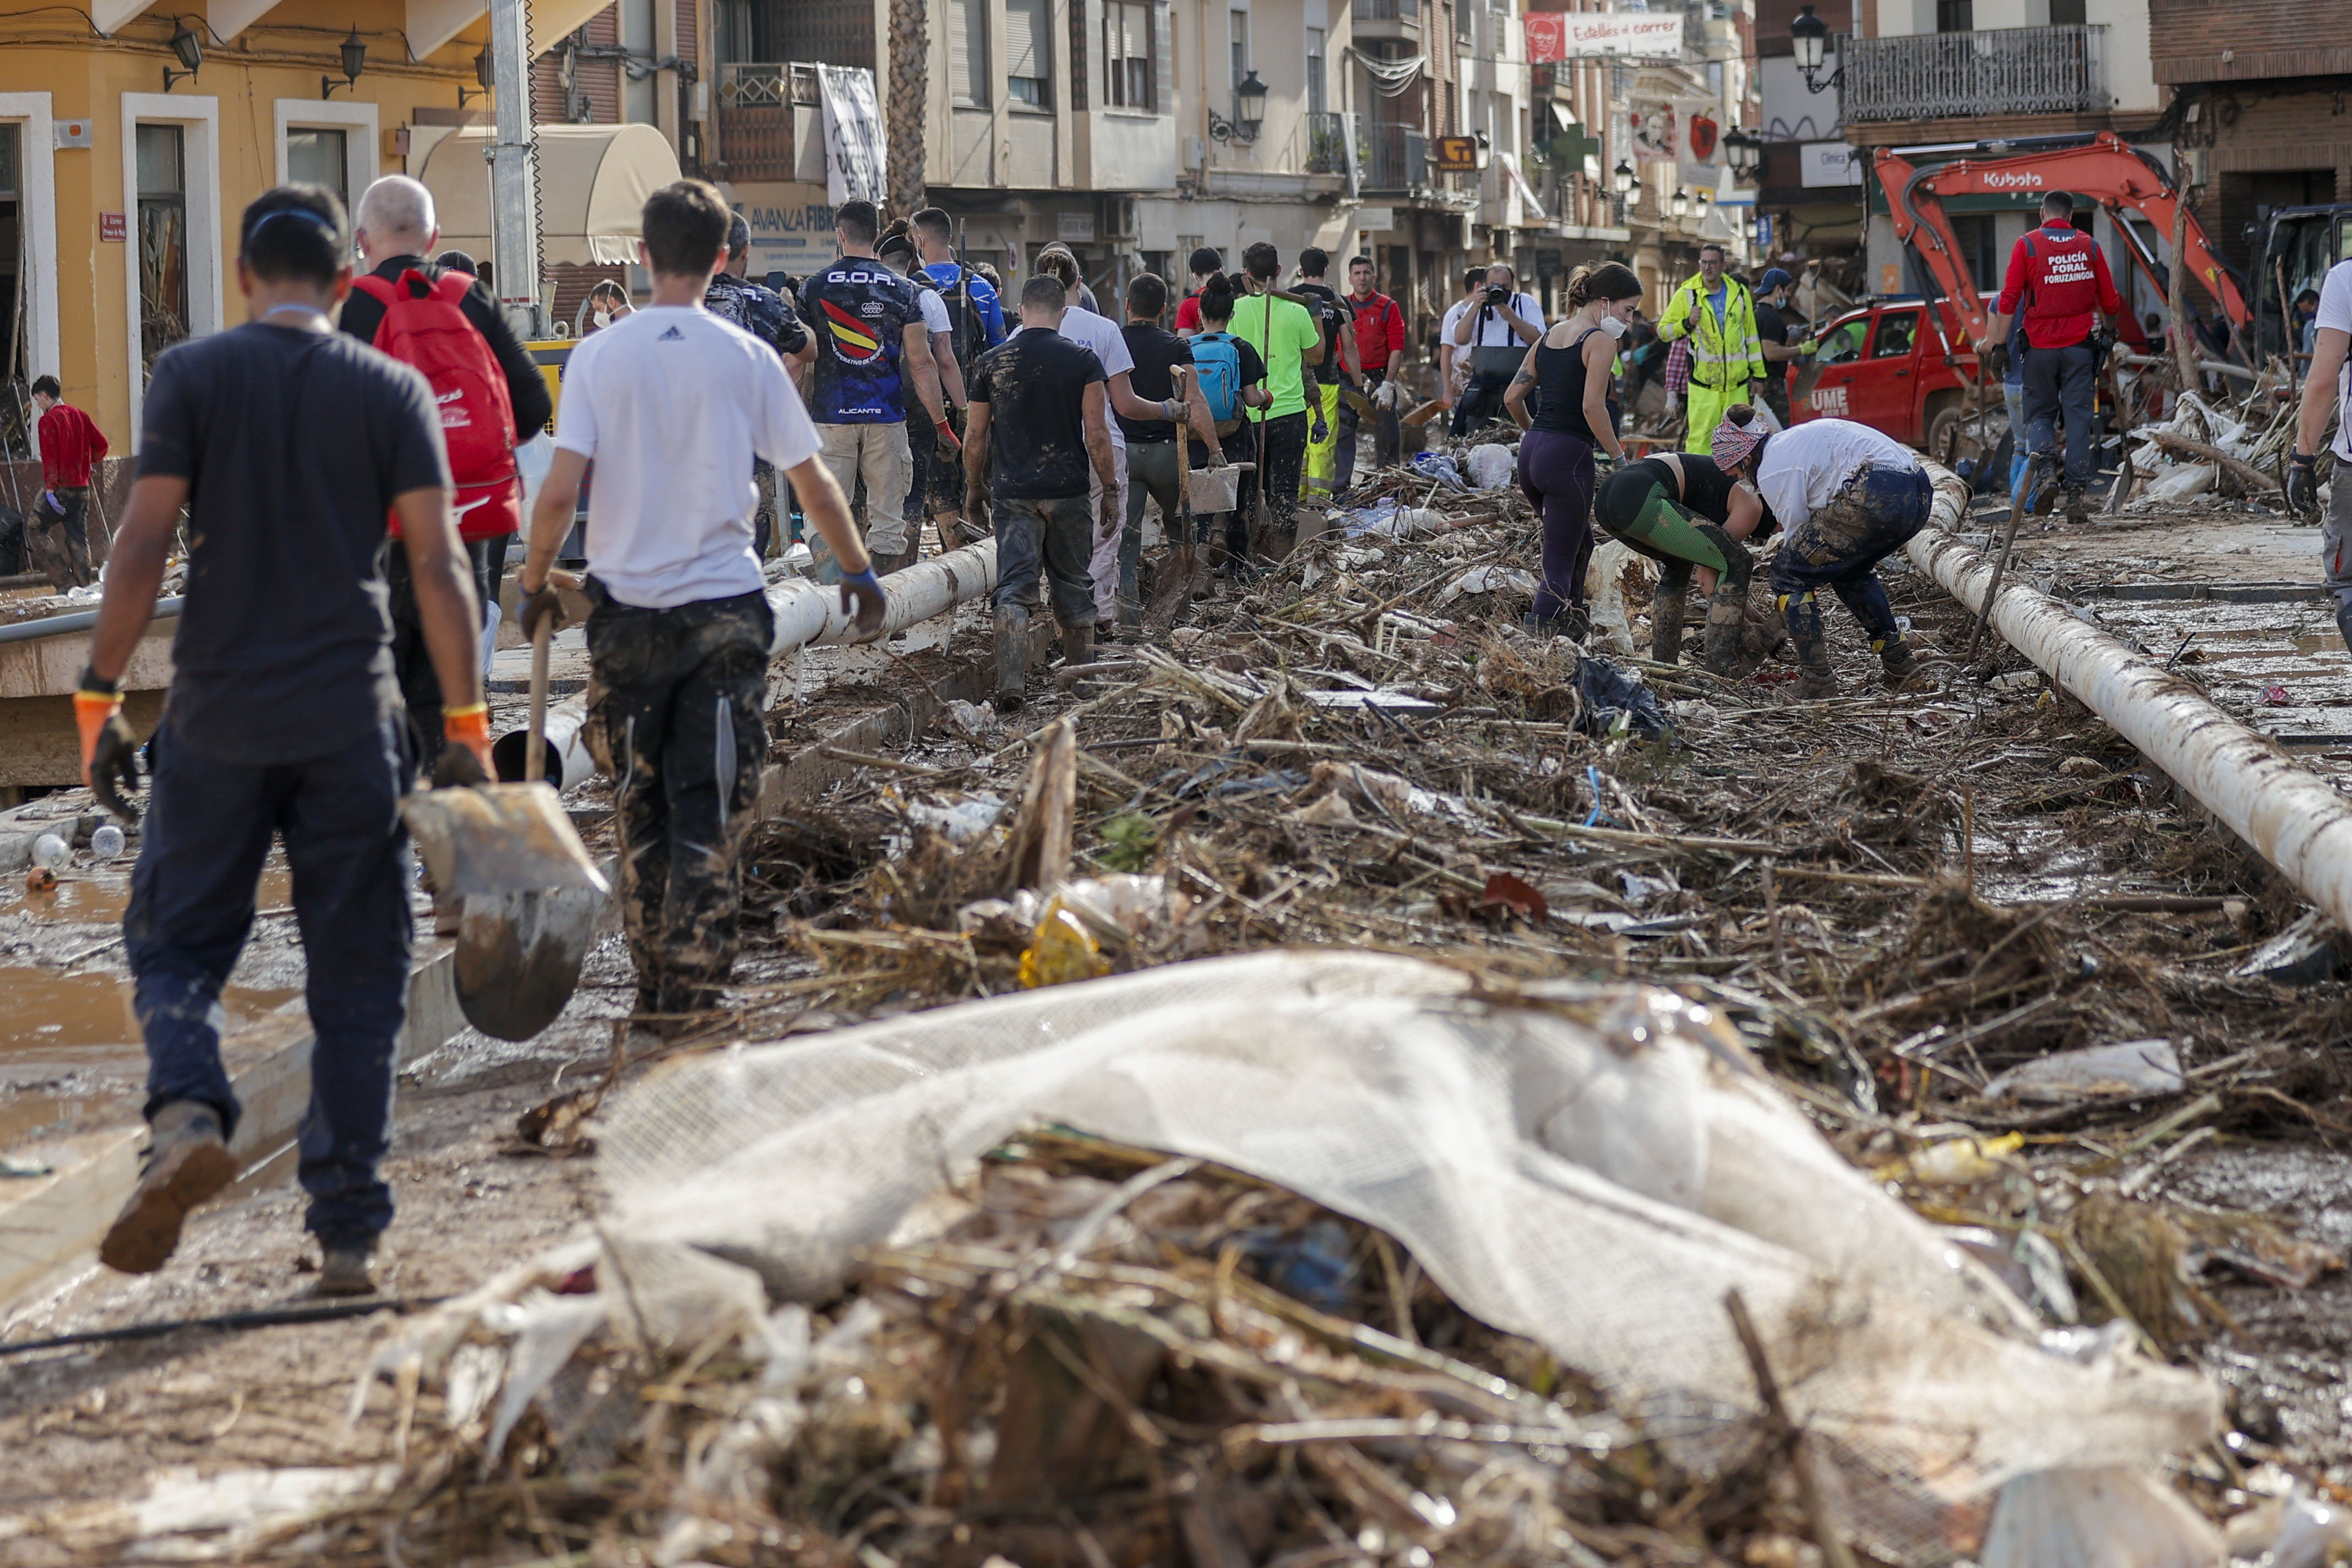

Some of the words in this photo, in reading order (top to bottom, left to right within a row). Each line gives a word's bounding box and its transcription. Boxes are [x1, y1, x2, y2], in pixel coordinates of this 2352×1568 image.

[1984, 171, 2043, 187] Kubota
[751, 205, 837, 232] AVANZAFIBR
[2048, 251, 2088, 265] POLICÍA
[2052, 263, 2087, 274] FORAL
[2044, 270, 2094, 285] FORUZAINGOA
[835, 351, 862, 366] OPERATIVO
[1811, 389, 1848, 411] UME
